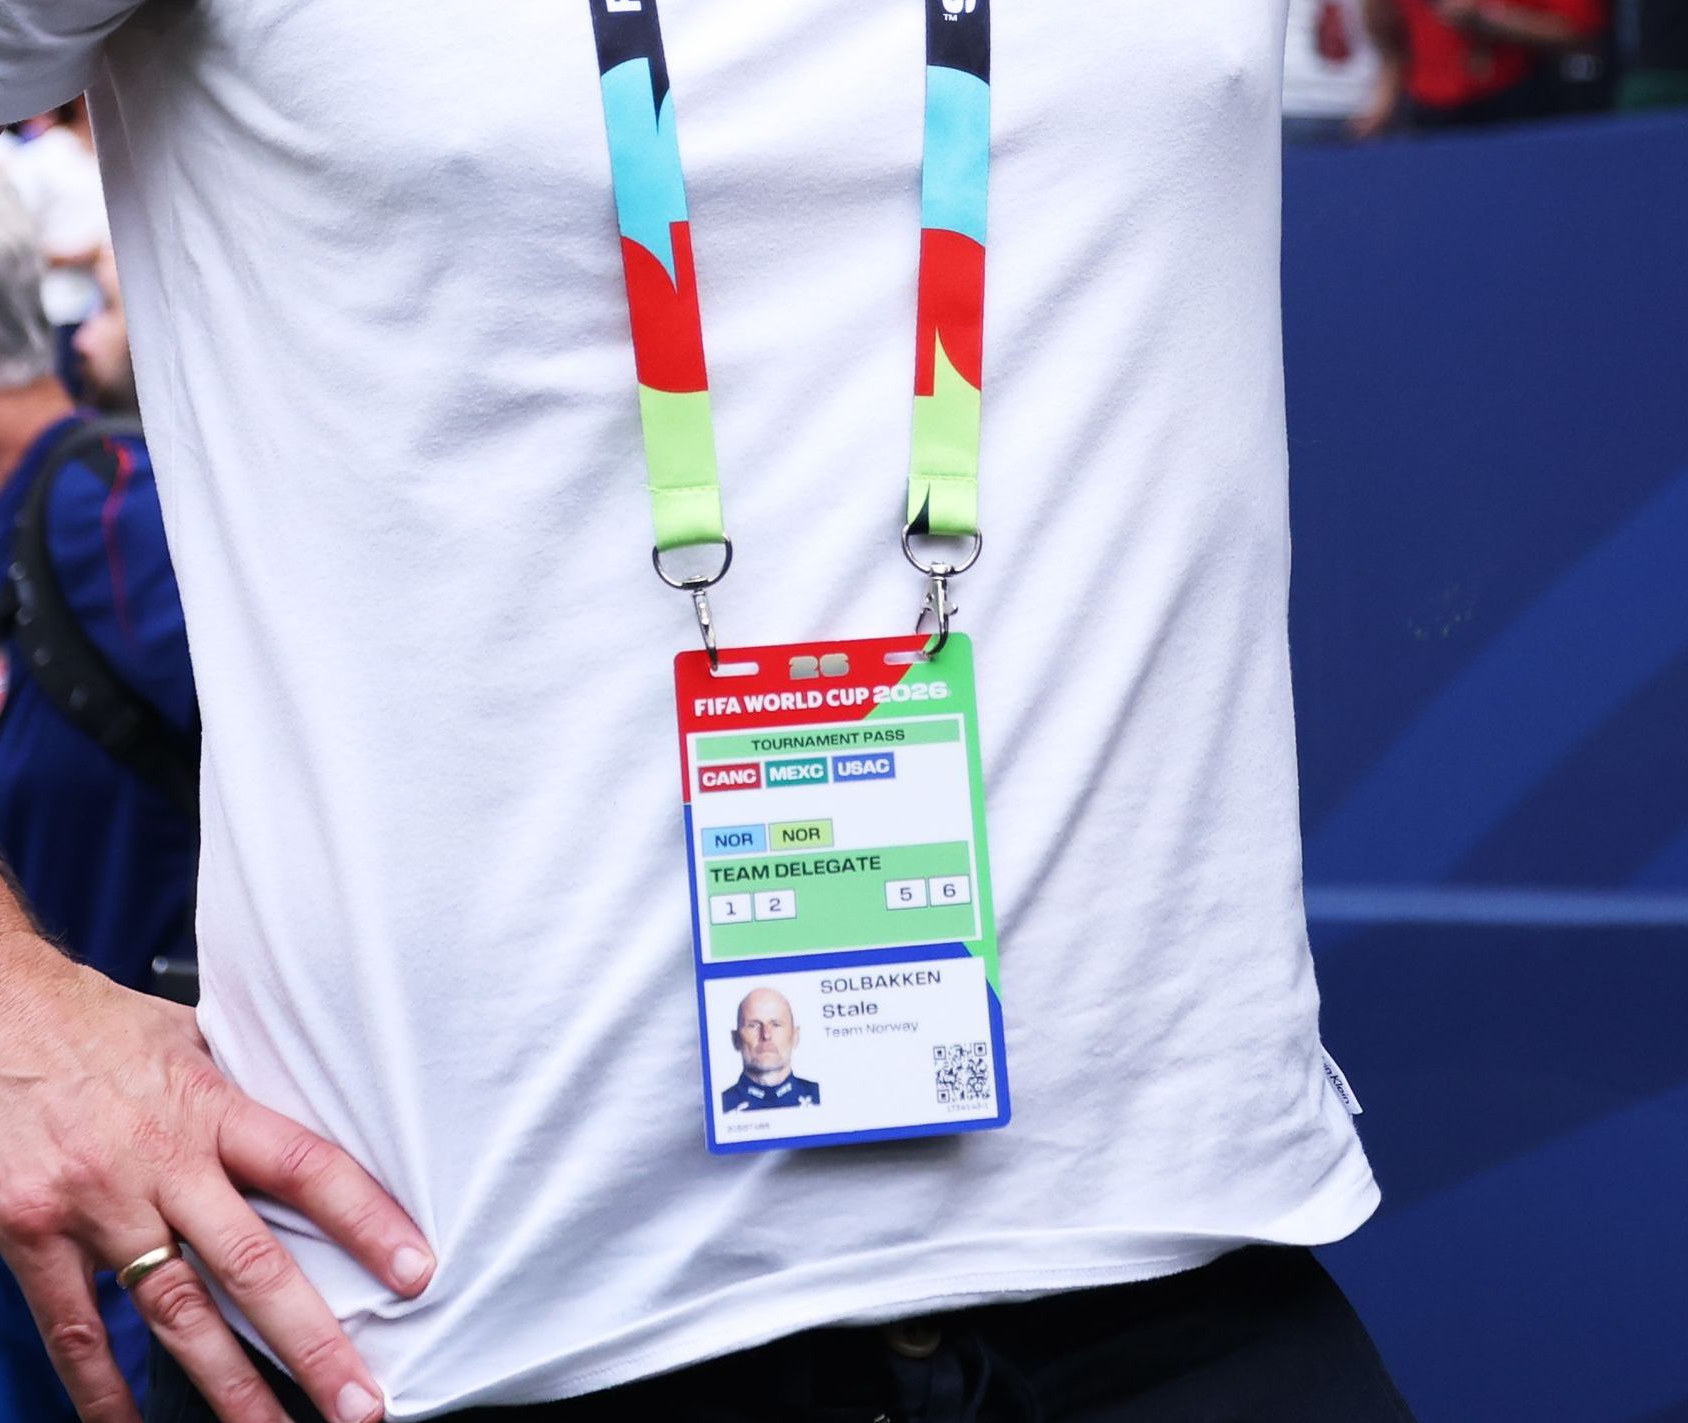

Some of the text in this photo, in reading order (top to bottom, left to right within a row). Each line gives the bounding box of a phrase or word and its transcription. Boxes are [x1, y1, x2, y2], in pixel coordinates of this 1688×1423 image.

[694, 681, 949, 717] FIFA WORLD CUP 2026
[751, 728, 906, 752] TOURNAMENT PASS
[702, 758, 891, 787] CANC MEXC USAC
[715, 827, 821, 848] NOR NOR
[710, 855, 882, 883] TEAM DELEGATE
[726, 883, 956, 916] 1 2 5 6
[820, 970, 942, 995] SOLBAKKEN
[822, 1001, 879, 1019] Stale
[824, 1020, 919, 1039] Team Norway
